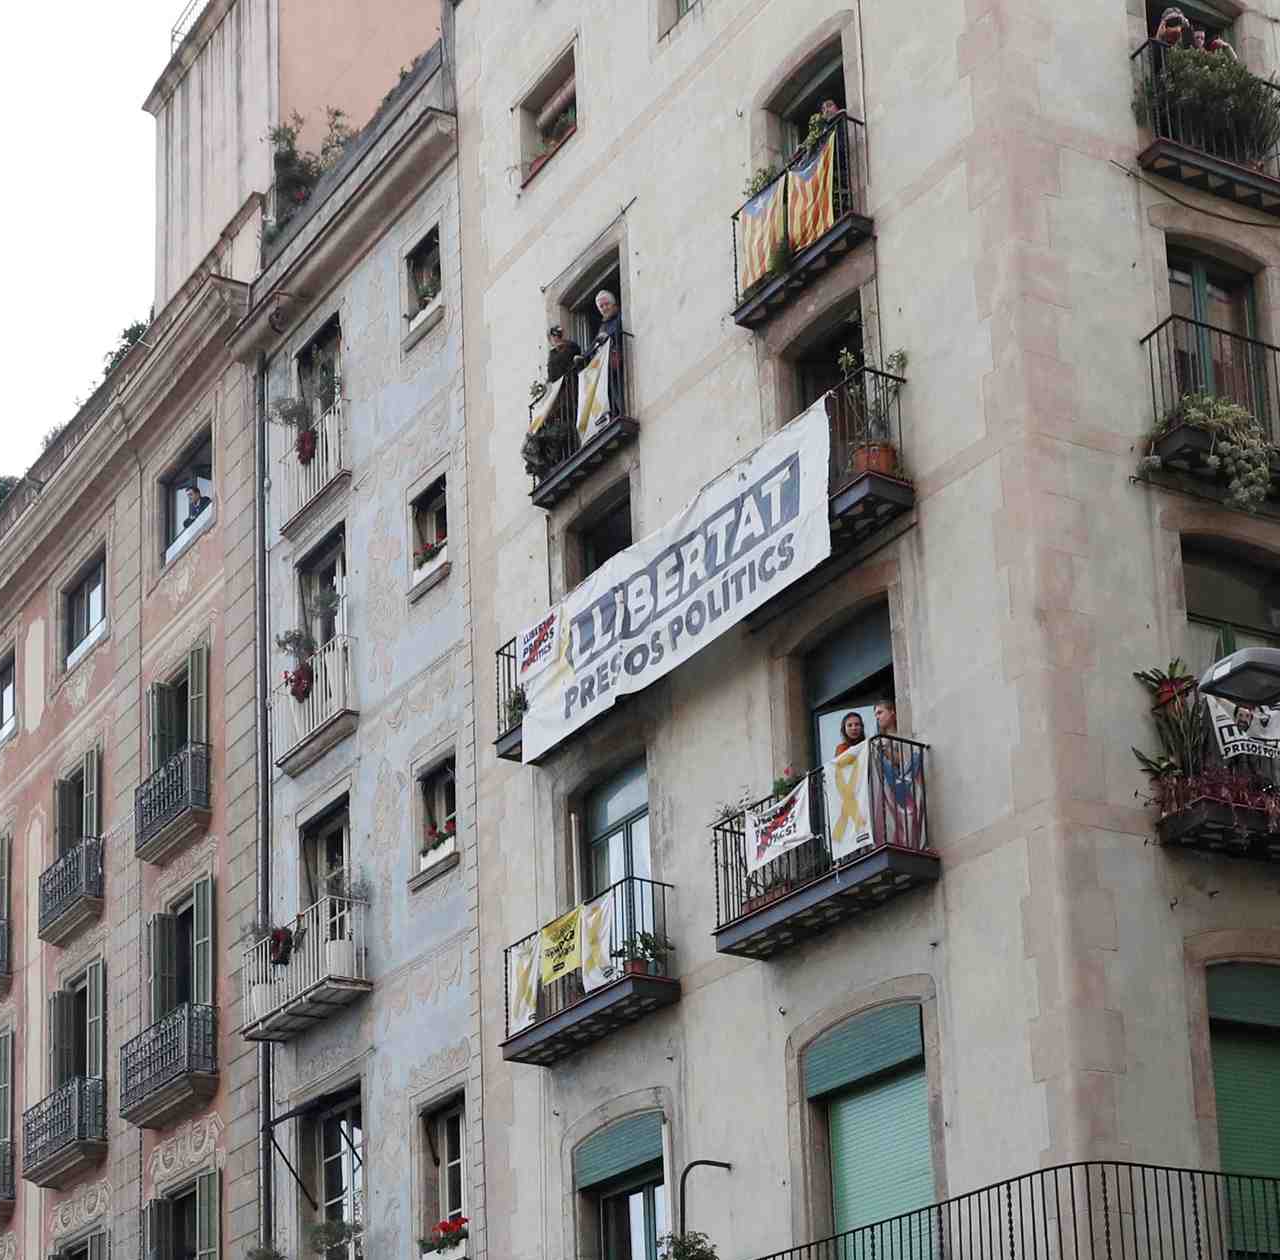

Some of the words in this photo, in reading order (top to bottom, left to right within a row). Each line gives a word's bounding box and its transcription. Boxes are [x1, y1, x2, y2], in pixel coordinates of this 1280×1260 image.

[564, 631, 665, 720] PRESOS
[670, 532, 795, 651] POLÍTICS
[572, 462, 798, 661] LLIBERTAT
